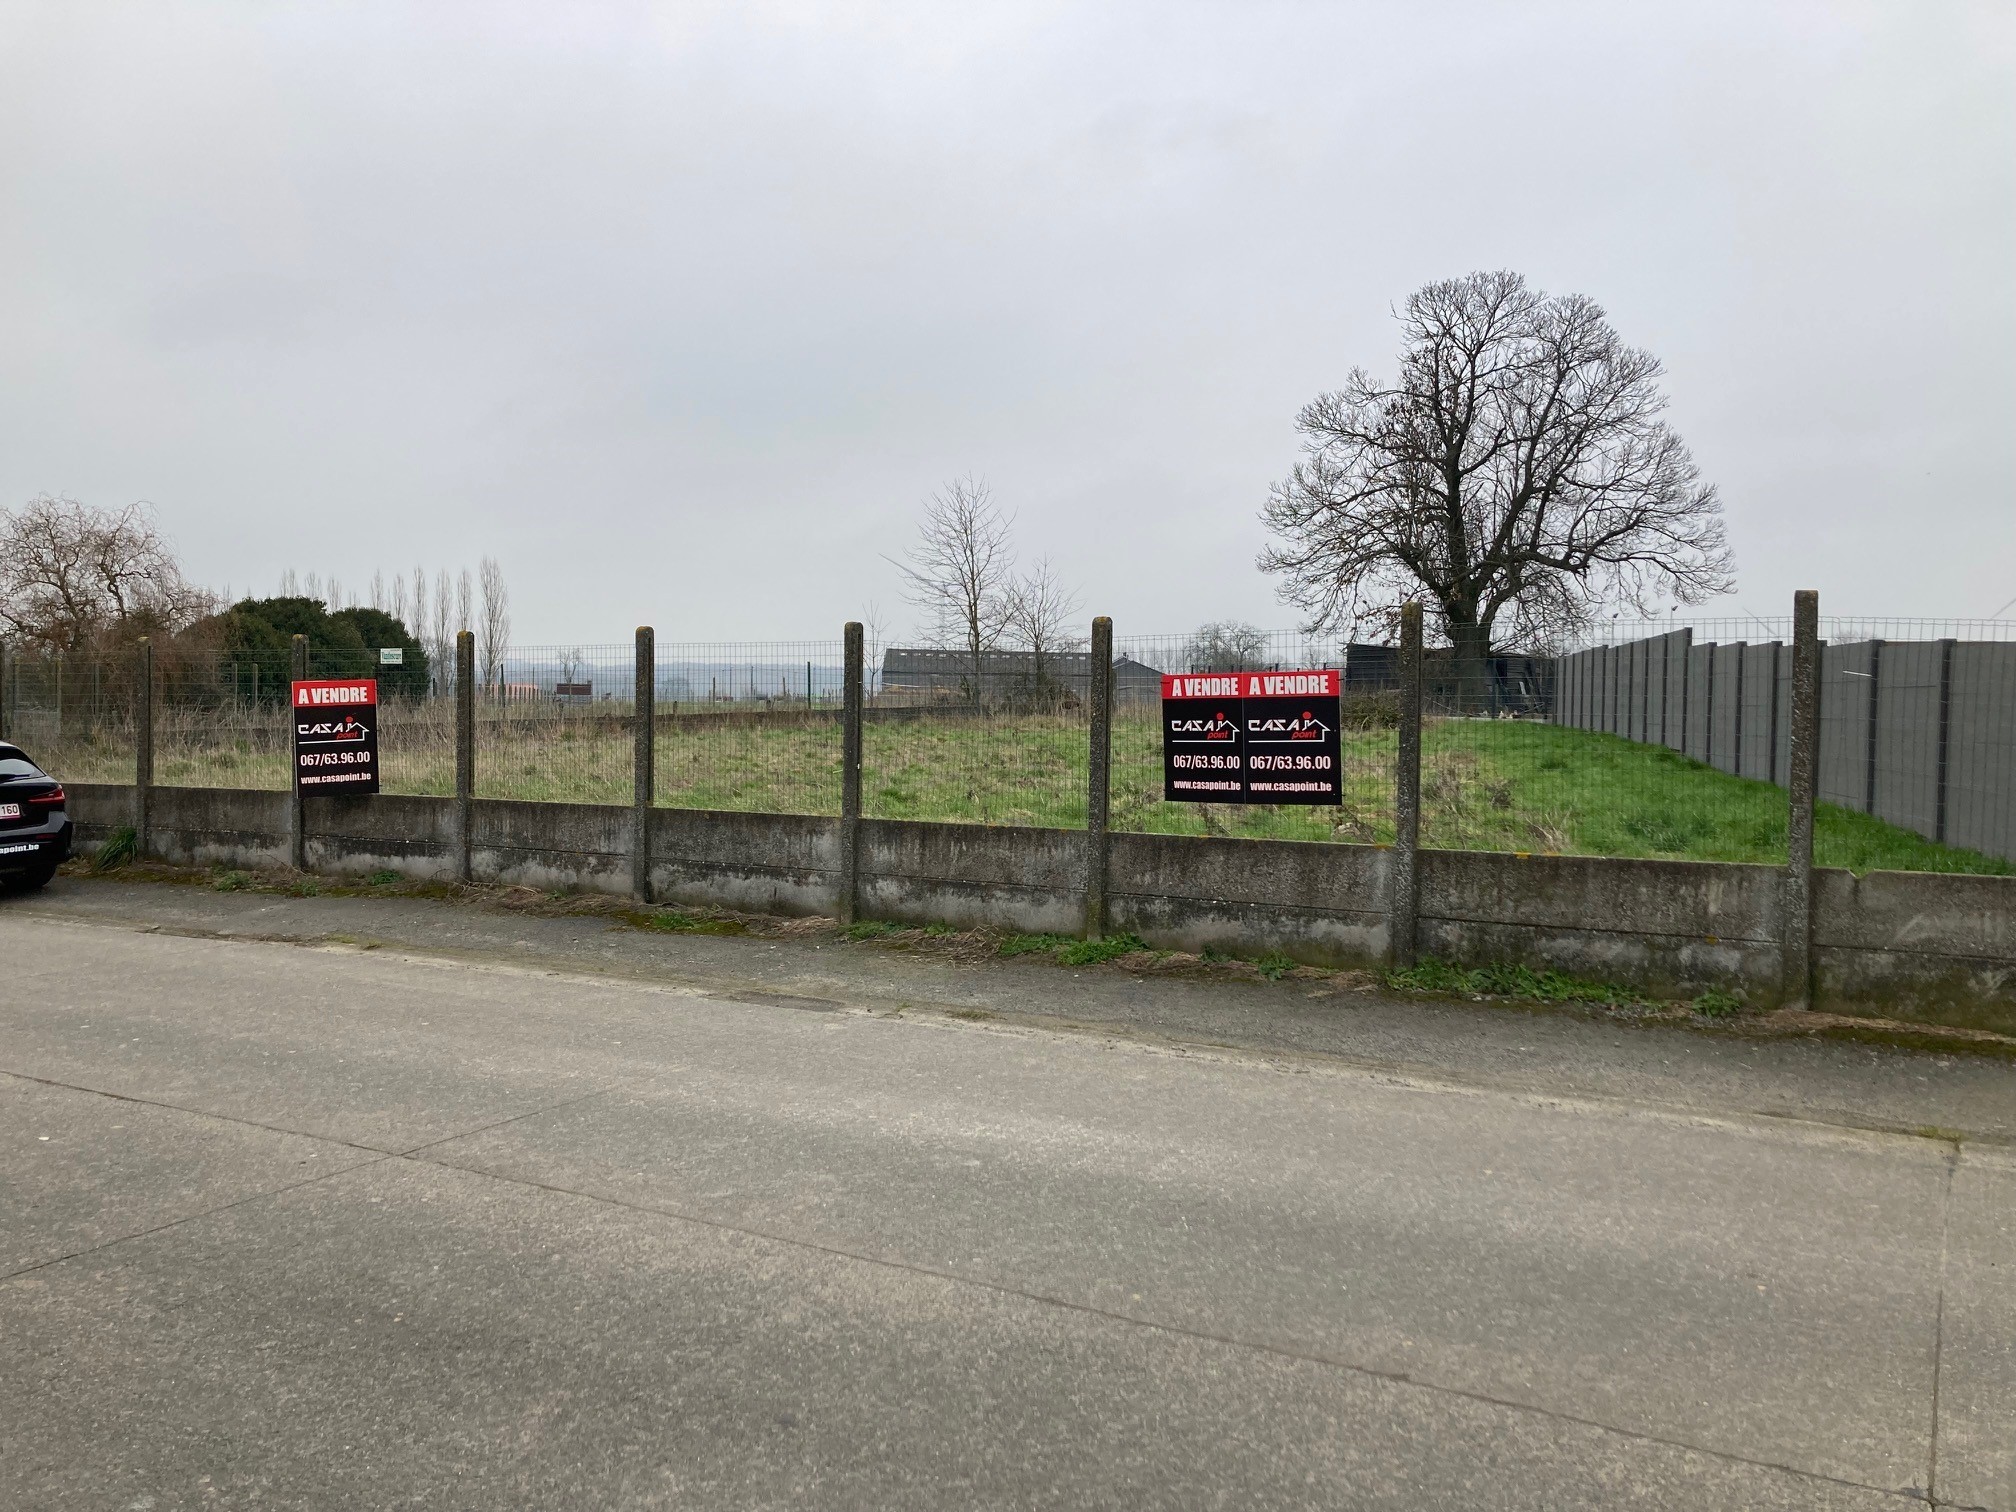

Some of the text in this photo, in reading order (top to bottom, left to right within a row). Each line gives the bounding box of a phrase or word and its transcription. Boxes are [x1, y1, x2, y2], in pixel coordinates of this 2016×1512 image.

[1172, 677, 1239, 697] A VENDRE
[1249, 674, 1329, 695] A VENDRE
[298, 687, 368, 704] A VENDRE
[336, 731, 358, 740] point
[1207, 730, 1228, 740] point
[1291, 730, 1317, 740] point
[300, 751, 370, 766] 067/63.96.00
[1173, 754, 1241, 770] 067/63.96.00
[1249, 755, 1331, 771] 067/63.96.00
[300, 772, 371, 784] www.casapoint.be
[1173, 780, 1241, 791] www.casapoint.be
[1250, 781, 1332, 792] www.casapoint.be
[2, 804, 18, 815] 160
